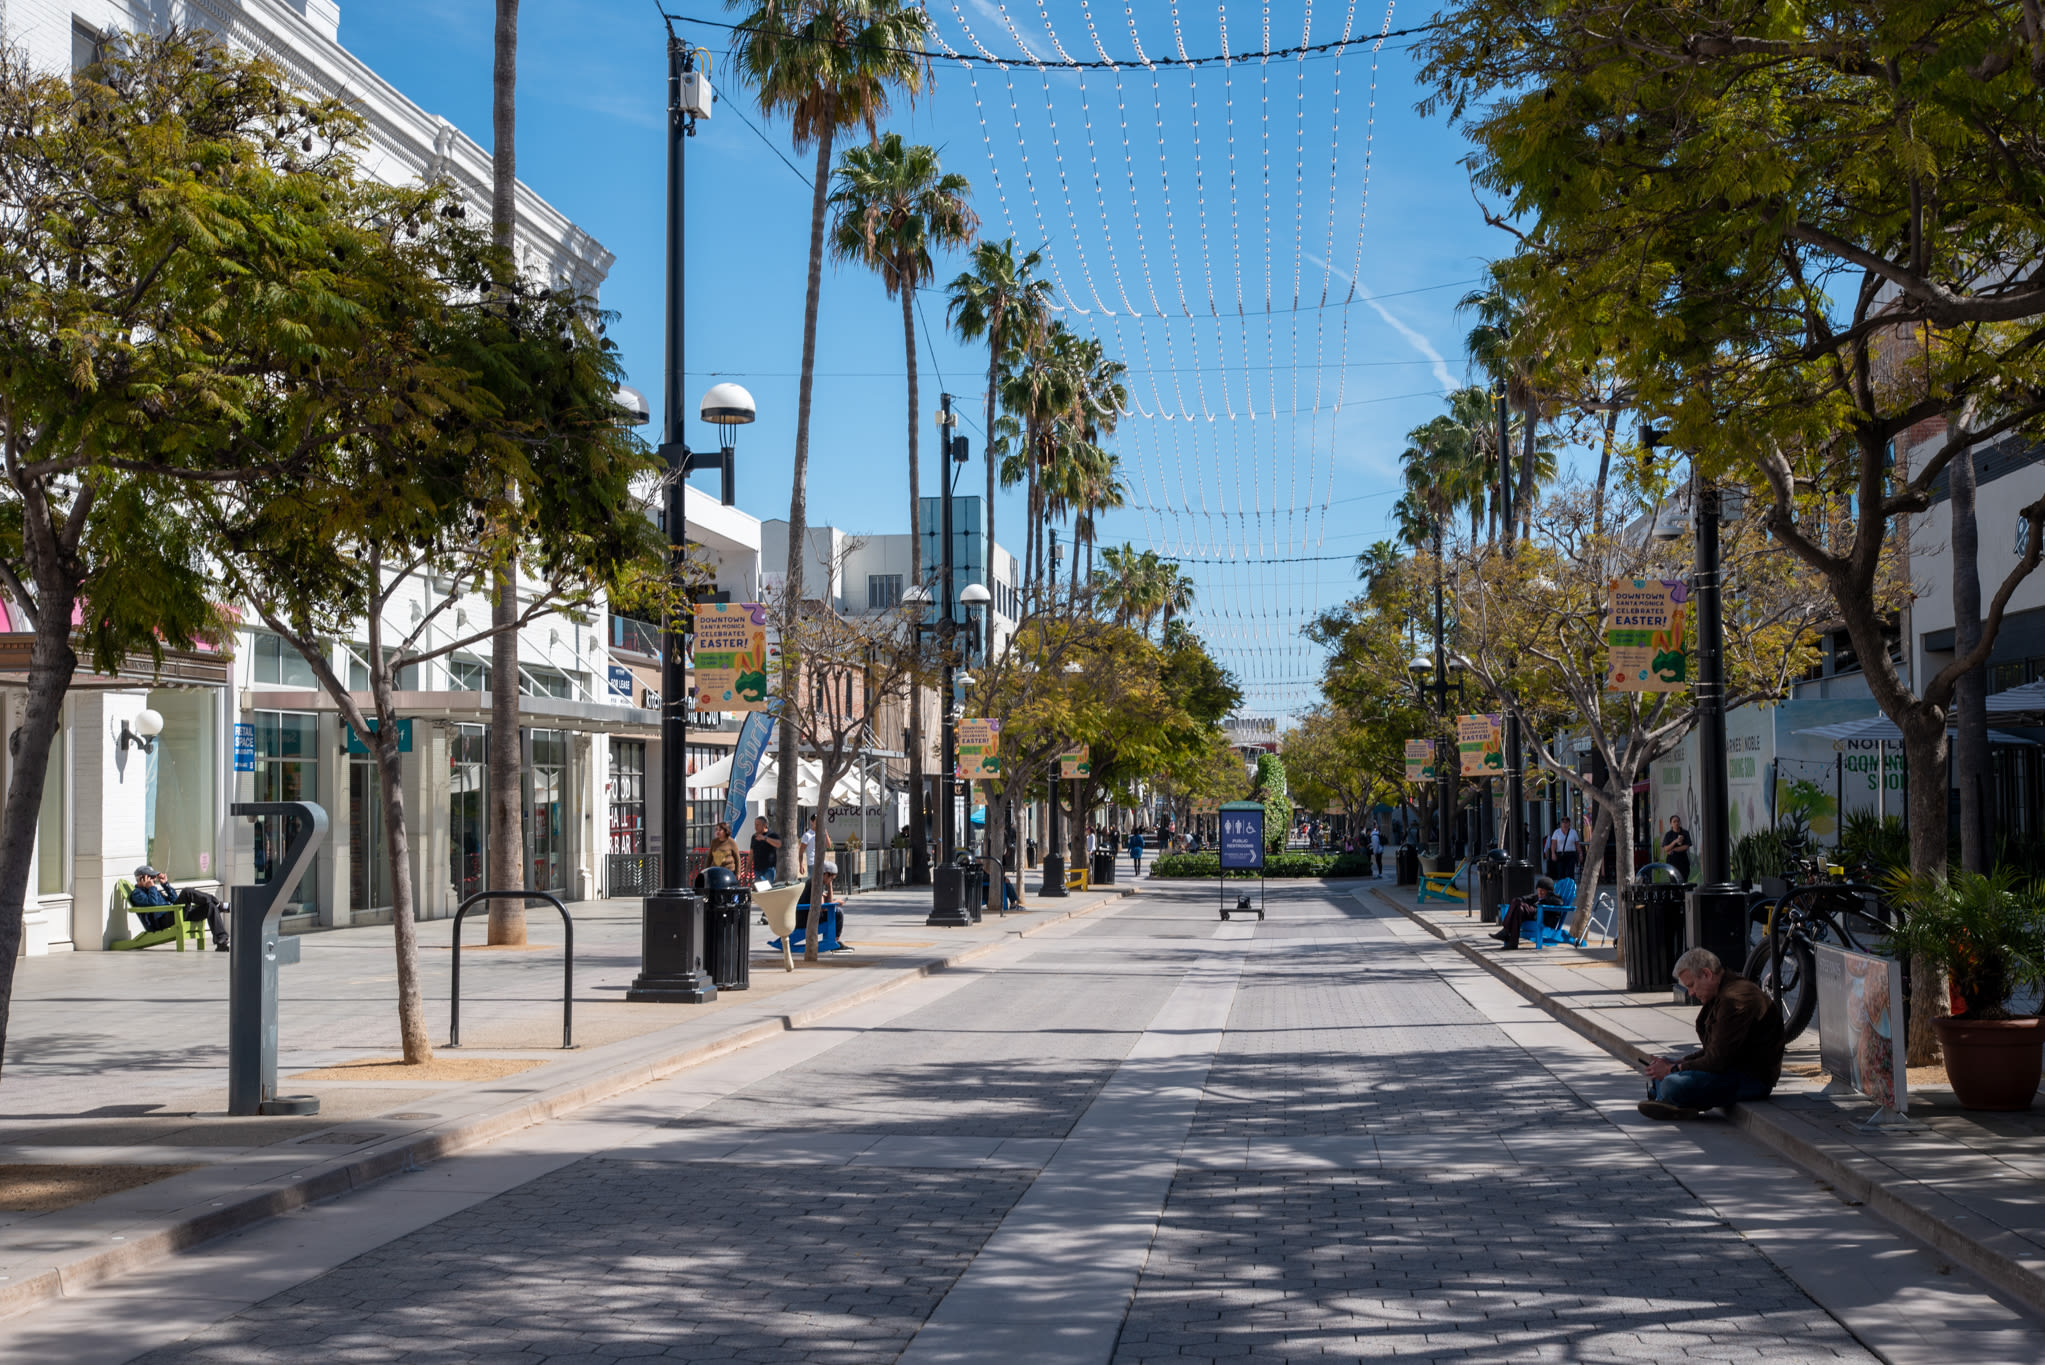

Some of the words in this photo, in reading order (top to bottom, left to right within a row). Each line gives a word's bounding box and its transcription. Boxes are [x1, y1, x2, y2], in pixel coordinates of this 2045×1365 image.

[1616, 616, 1667, 627] EASTER!
[700, 638, 748, 648] EASTER!
[619, 680, 630, 690] LEASE
[235, 726, 253, 737] RETAIL
[1462, 733, 1490, 741] EASTER!
[235, 736, 253, 748] SPACE
[736, 709, 769, 776] Surf
[1726, 738, 1742, 753] ARNES
